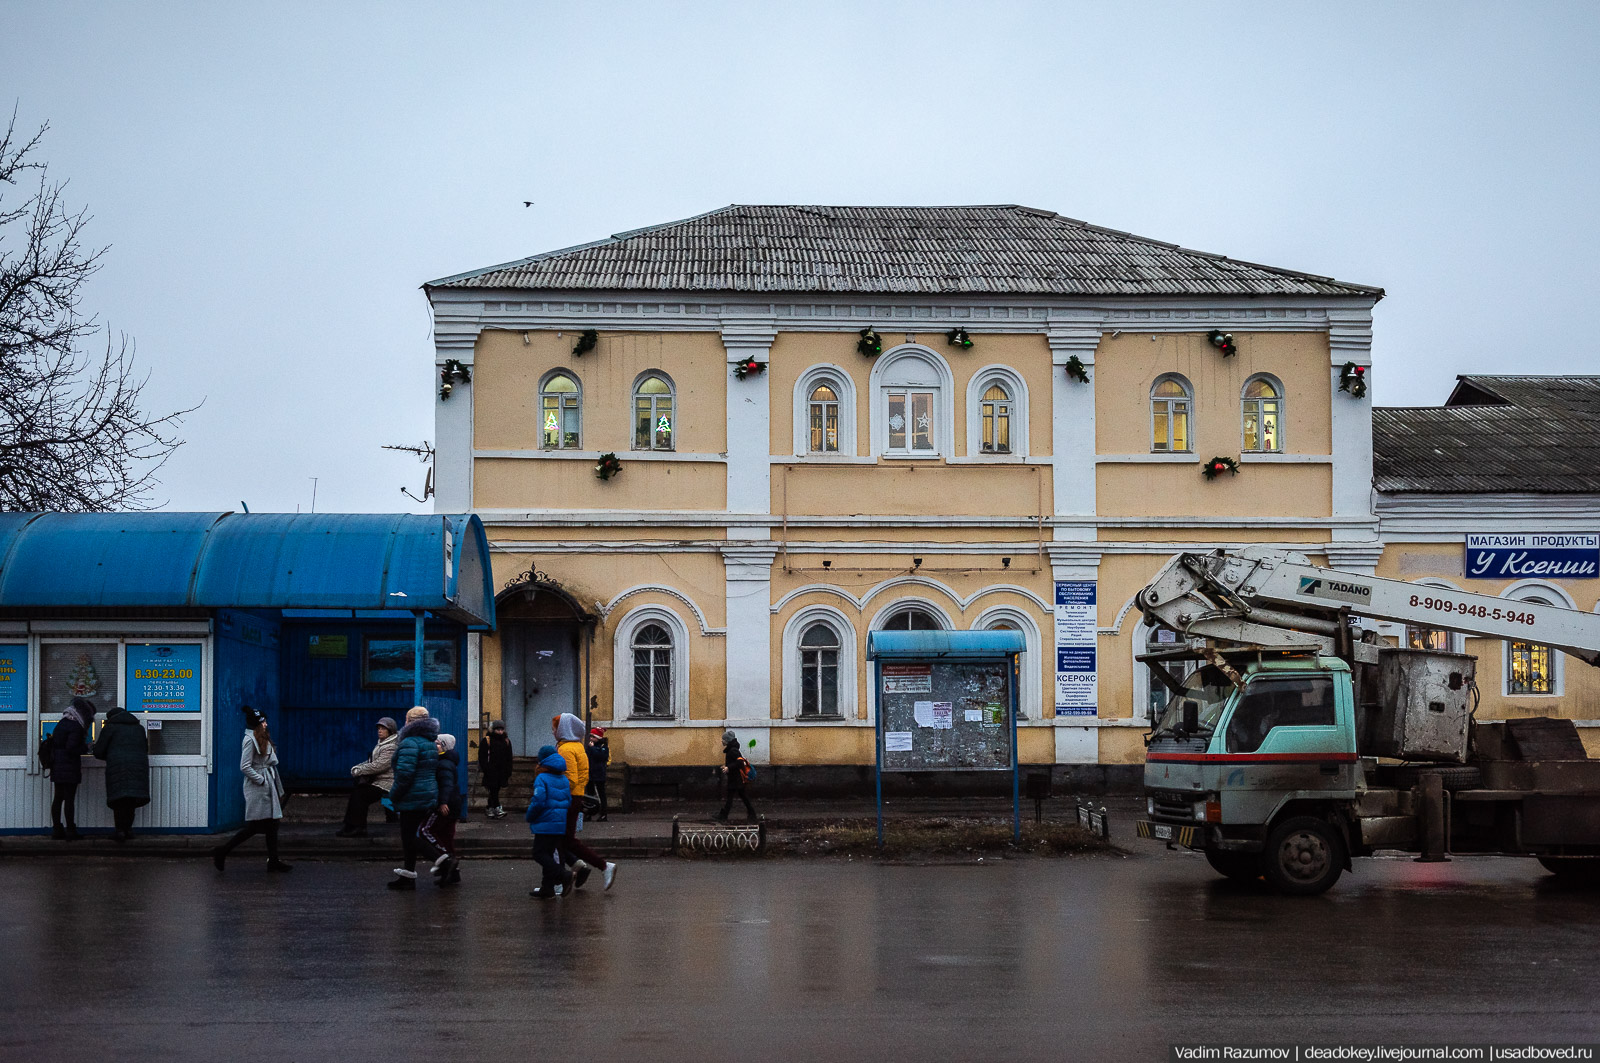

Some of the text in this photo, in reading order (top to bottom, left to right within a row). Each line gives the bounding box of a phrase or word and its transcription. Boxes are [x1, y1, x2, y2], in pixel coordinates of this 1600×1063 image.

[1470, 536, 1597, 547] МАГАЗИН ПРОДУКТЫ
[1471, 551, 1596, 574] У Ксении
[1328, 582, 1370, 596] TADANO
[1409, 595, 1535, 625] 8-909-948-5-948
[135, 669, 193, 678] 8.30-23.00
